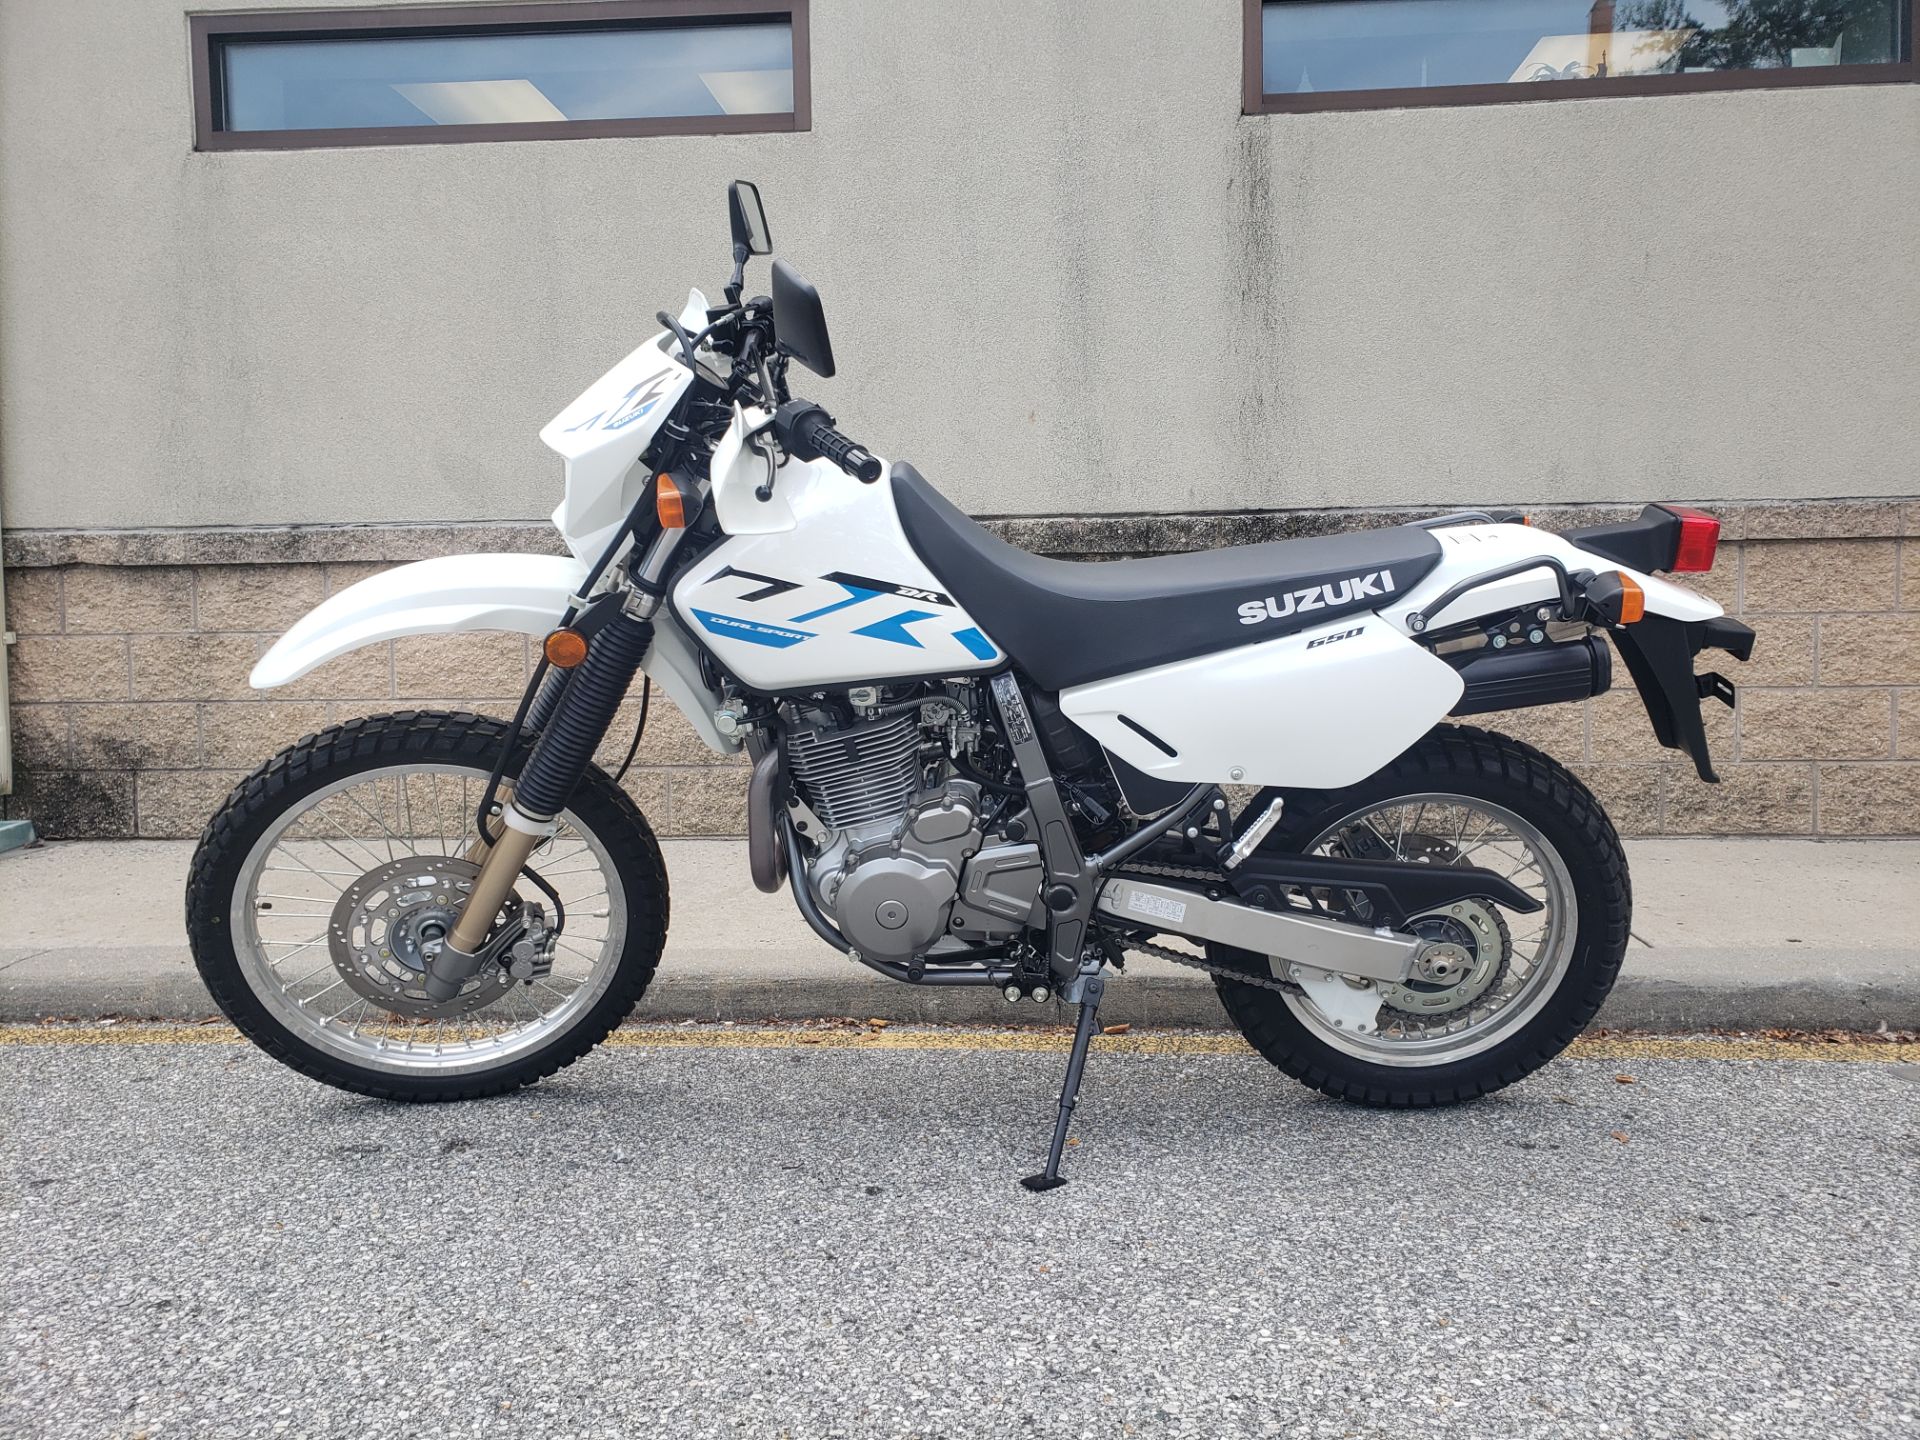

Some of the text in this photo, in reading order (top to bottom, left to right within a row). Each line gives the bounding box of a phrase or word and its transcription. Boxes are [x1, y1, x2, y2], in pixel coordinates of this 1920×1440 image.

[613, 408, 644, 428] SUZUKI
[895, 586, 939, 603] DR
[1237, 569, 1396, 625] SUZUKI
[709, 616, 811, 641] DUAL SPORT
[1306, 626, 1365, 650] 650
